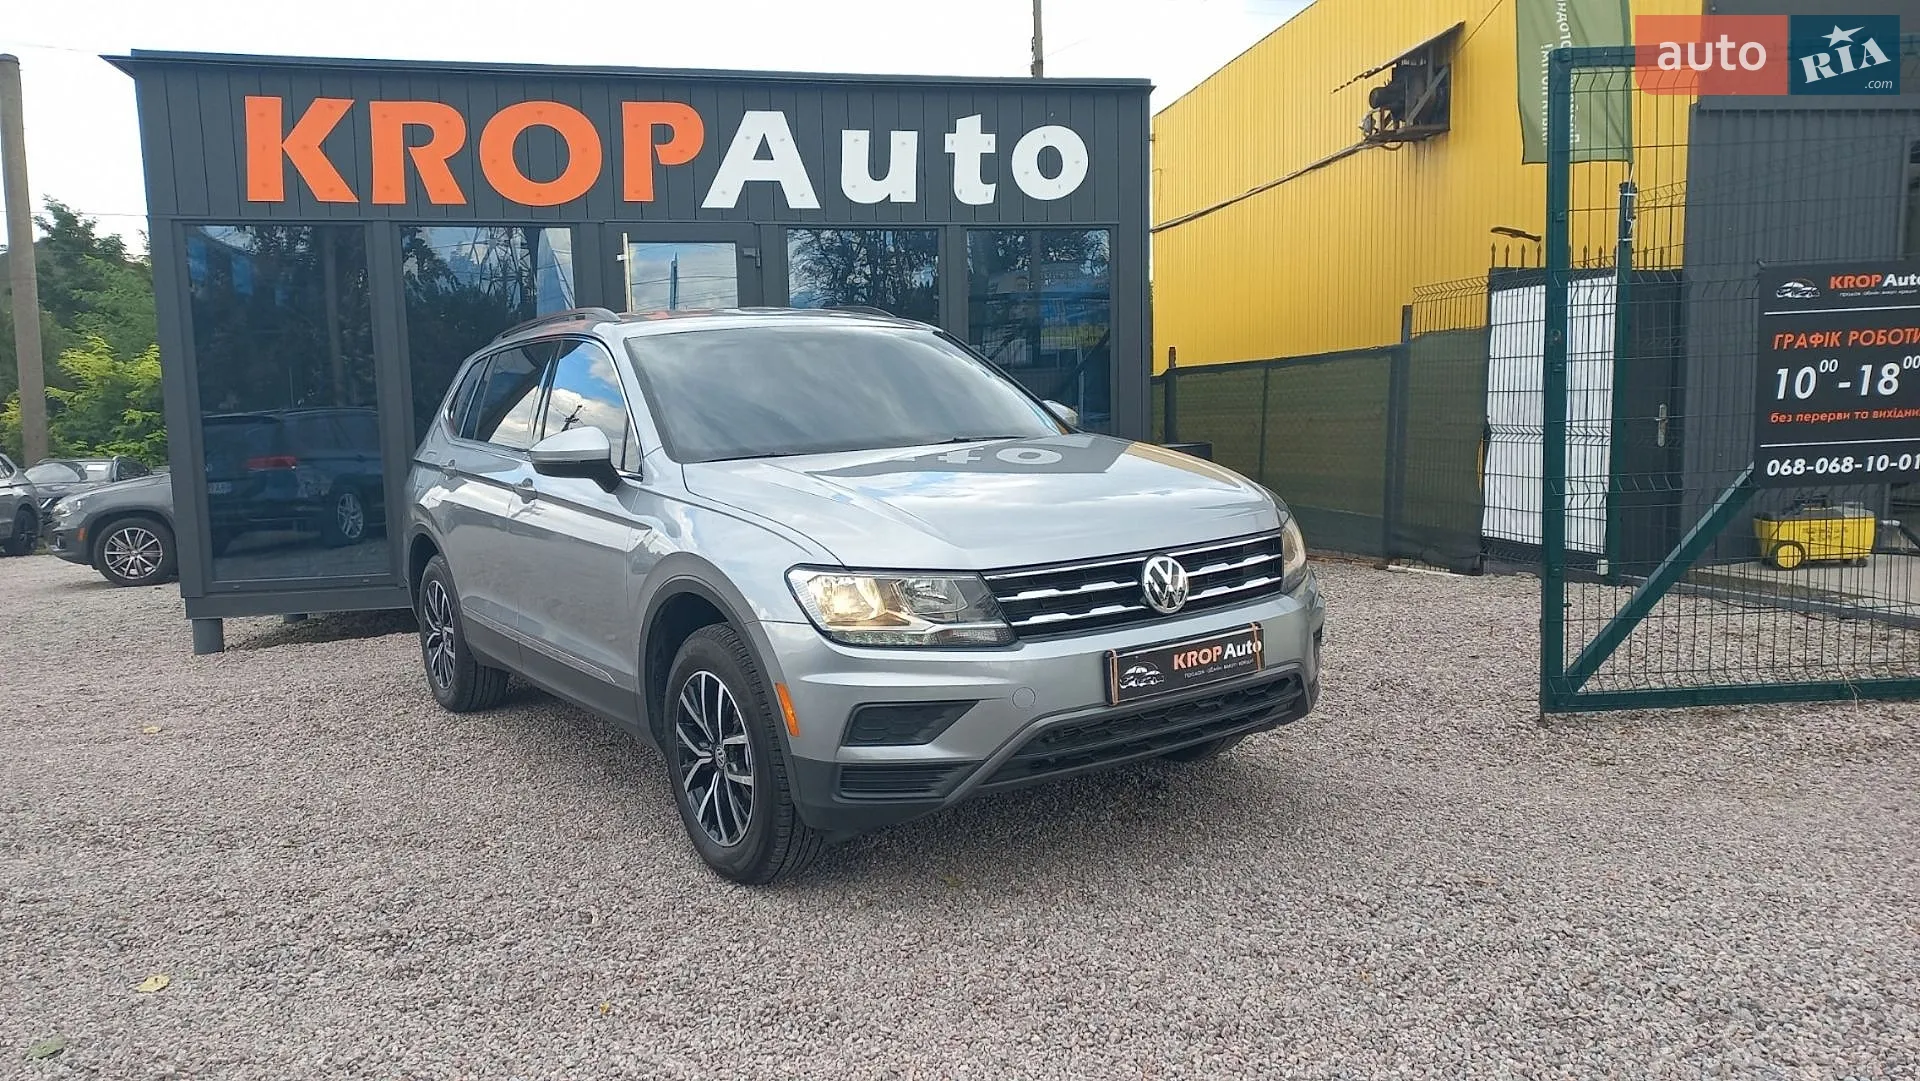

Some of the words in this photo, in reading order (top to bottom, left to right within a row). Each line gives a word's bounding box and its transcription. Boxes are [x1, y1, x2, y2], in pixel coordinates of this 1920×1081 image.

[1772, 331, 1843, 350] ГРАФІК
[1770, 412, 1792, 423] без
[1795, 411, 1850, 424] перерви
